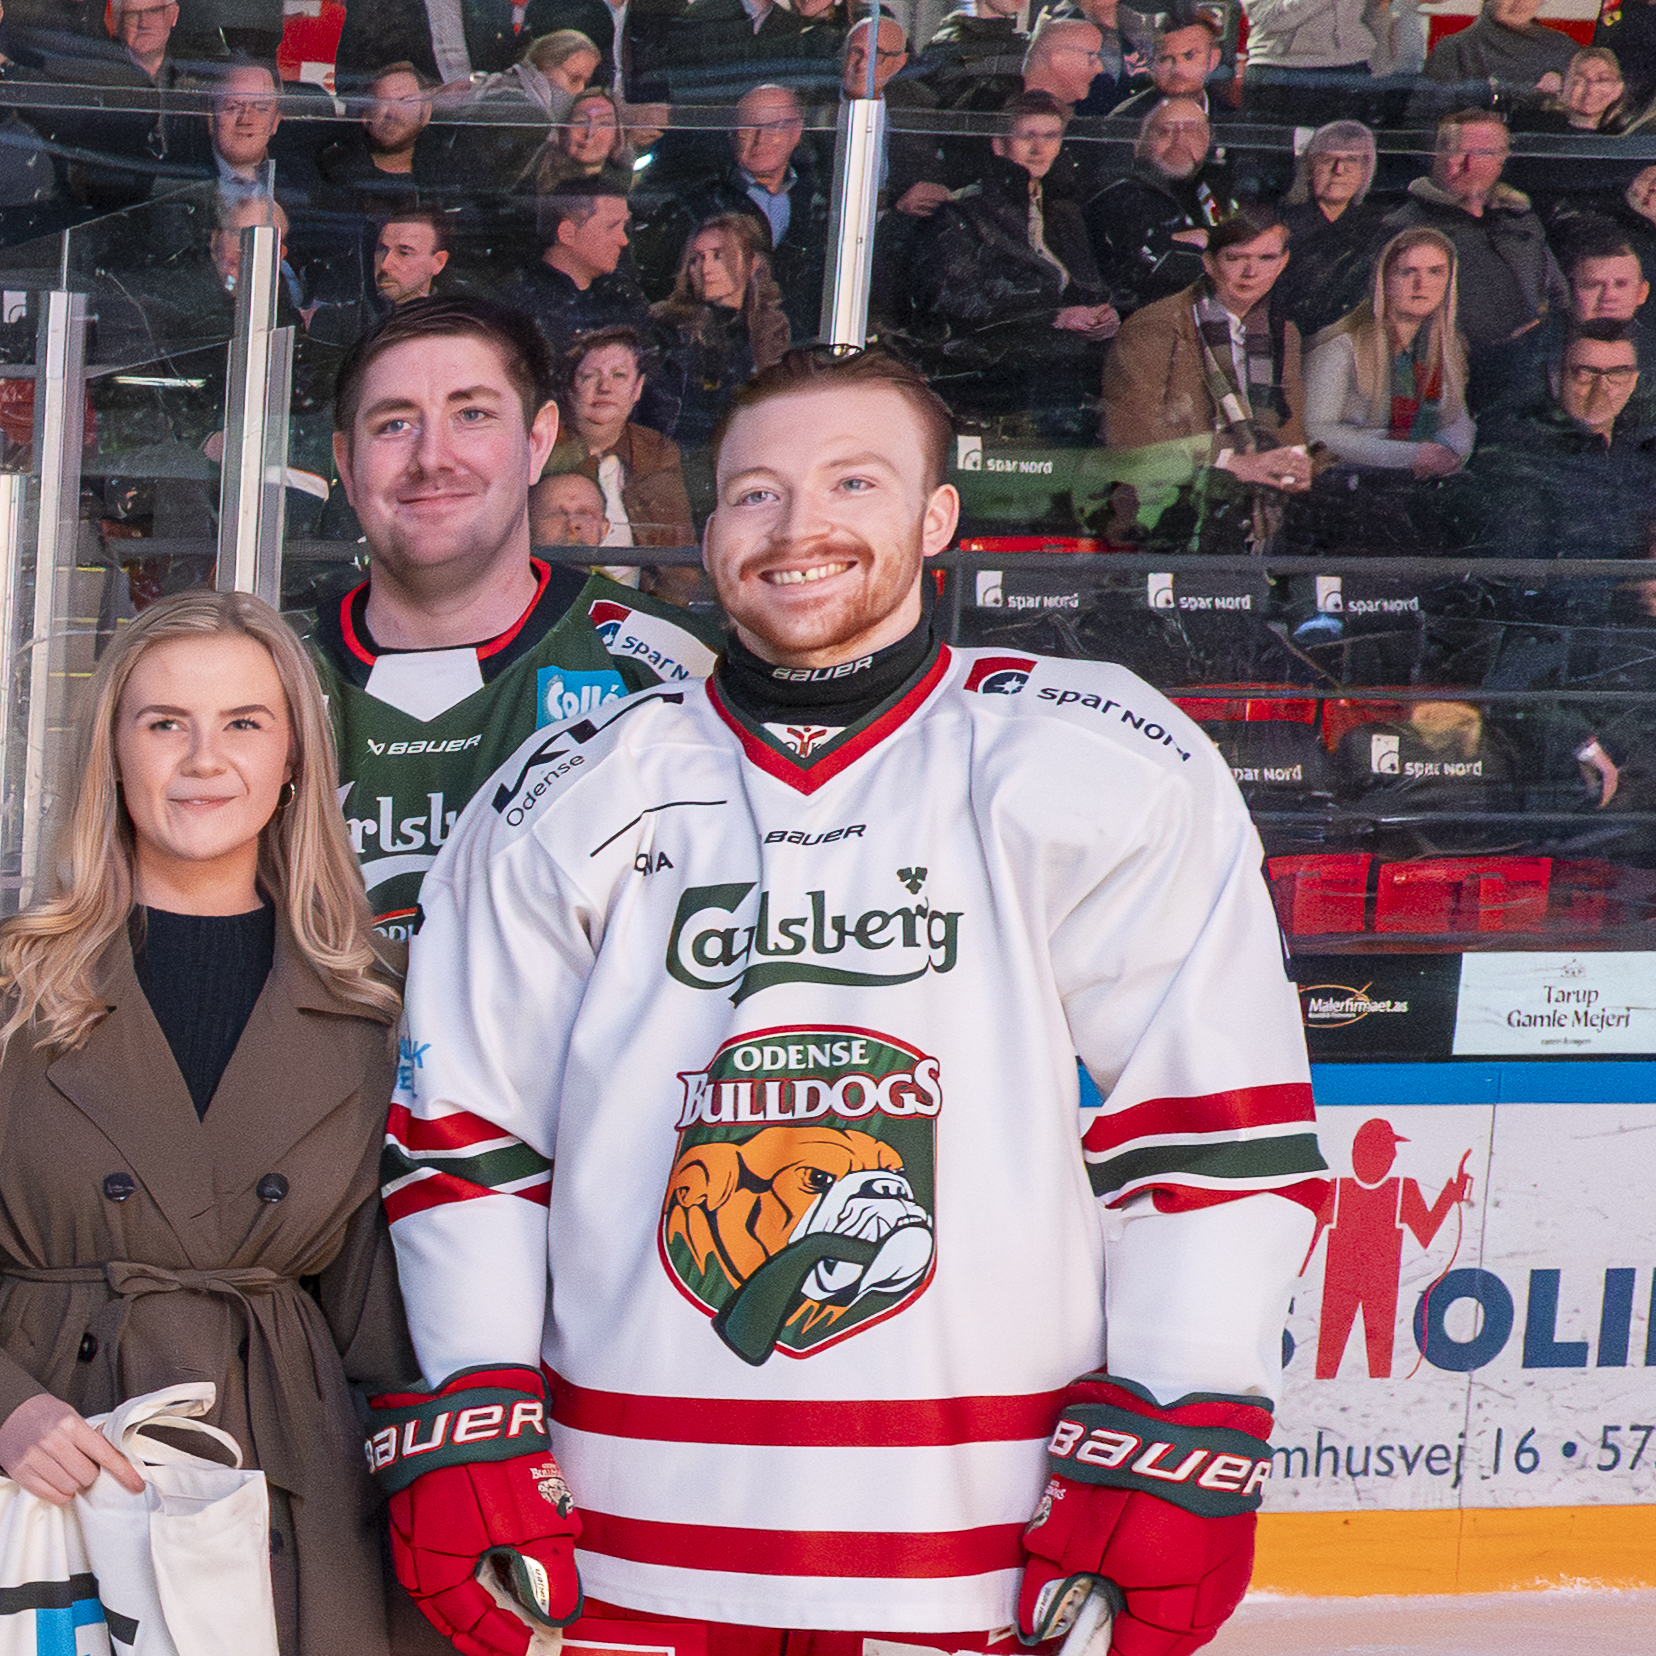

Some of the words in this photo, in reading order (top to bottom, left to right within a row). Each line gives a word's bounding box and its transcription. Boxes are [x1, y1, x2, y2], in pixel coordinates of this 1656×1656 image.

[506, 753, 586, 828] Odense
[1544, 986, 1599, 1005] Tarup
[1507, 1009, 1568, 1028] Gamle
[1572, 1008, 1631, 1033] Mejeri
[733, 1040, 870, 1071] ODENSE
